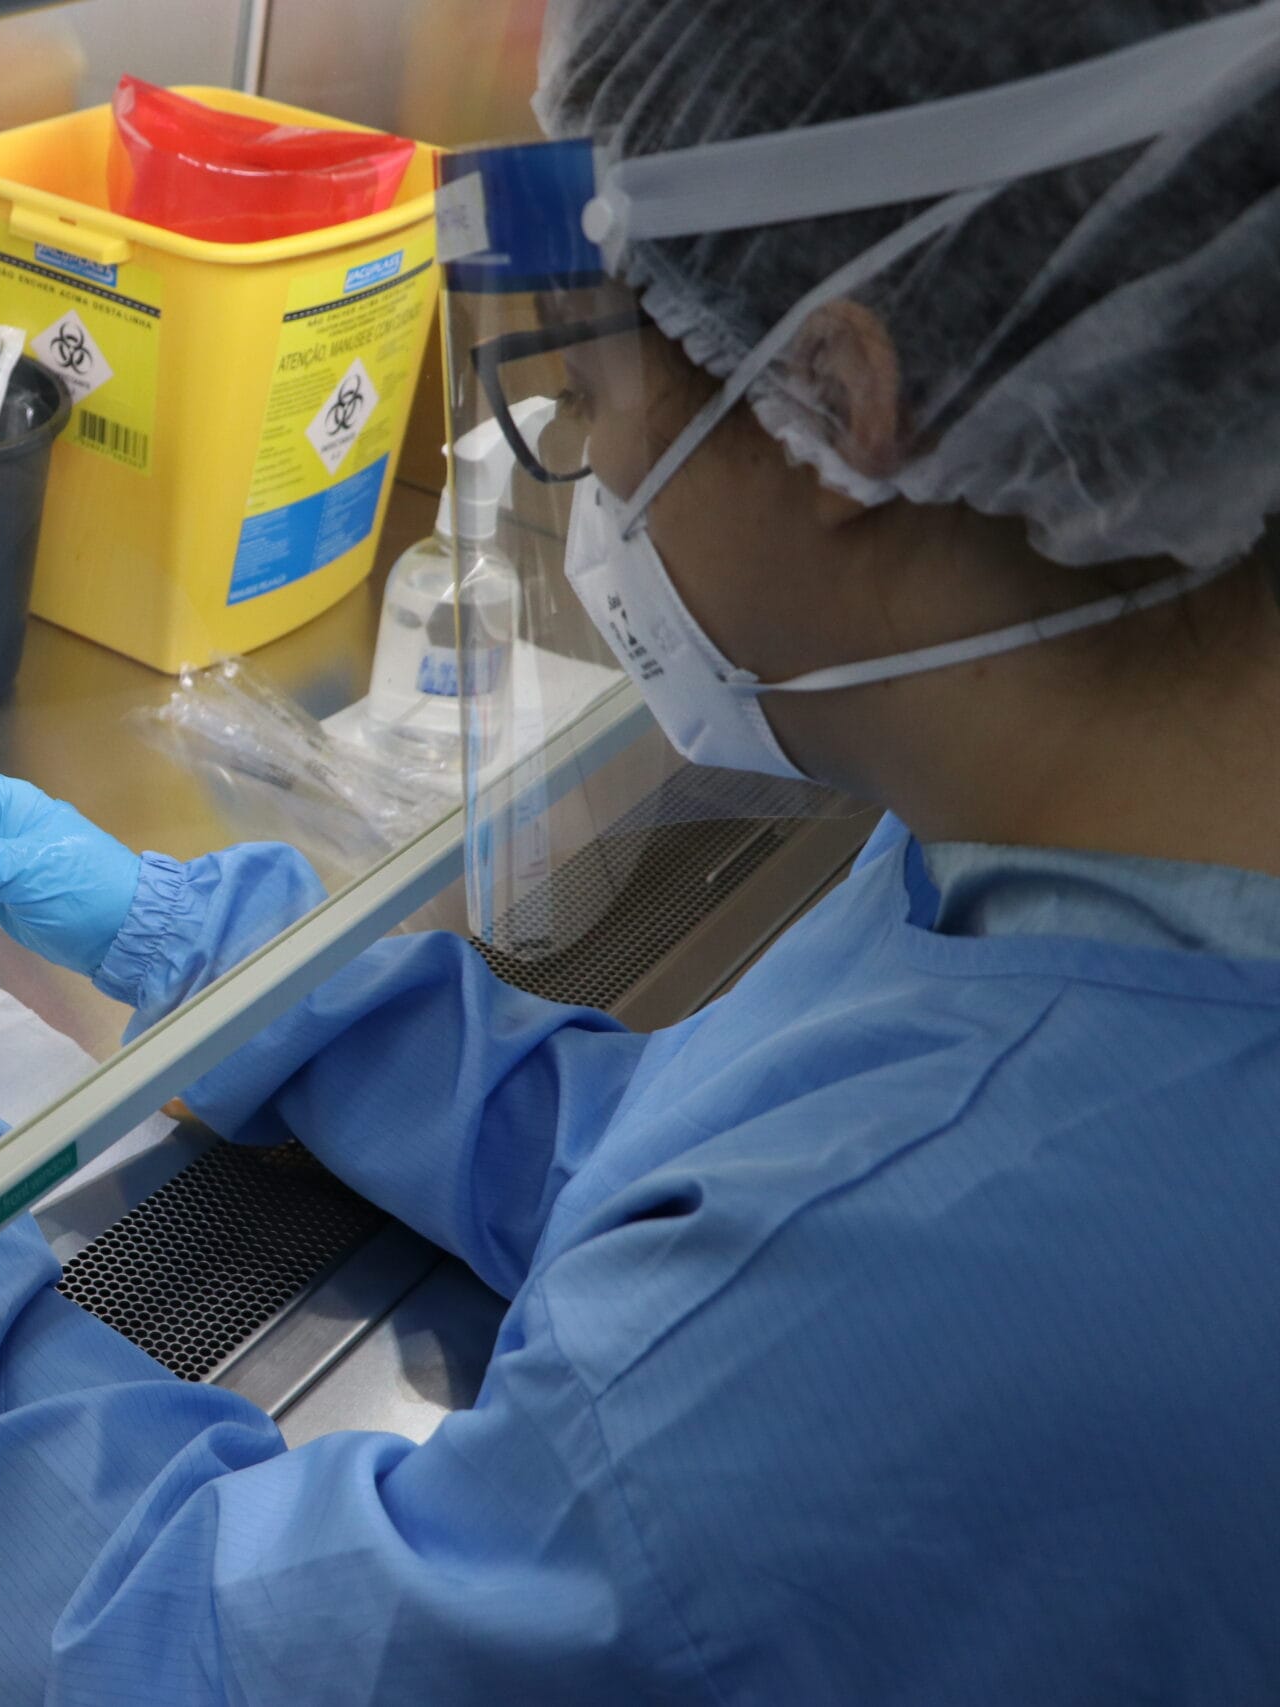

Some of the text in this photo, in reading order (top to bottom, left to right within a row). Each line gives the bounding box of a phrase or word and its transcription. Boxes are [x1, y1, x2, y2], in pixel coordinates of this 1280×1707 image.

[19, 274, 55, 294] ENCHER
[59, 288, 89, 306] ACIMA
[92, 300, 122, 319] DESTA
[2, 1183, 31, 1210] front
